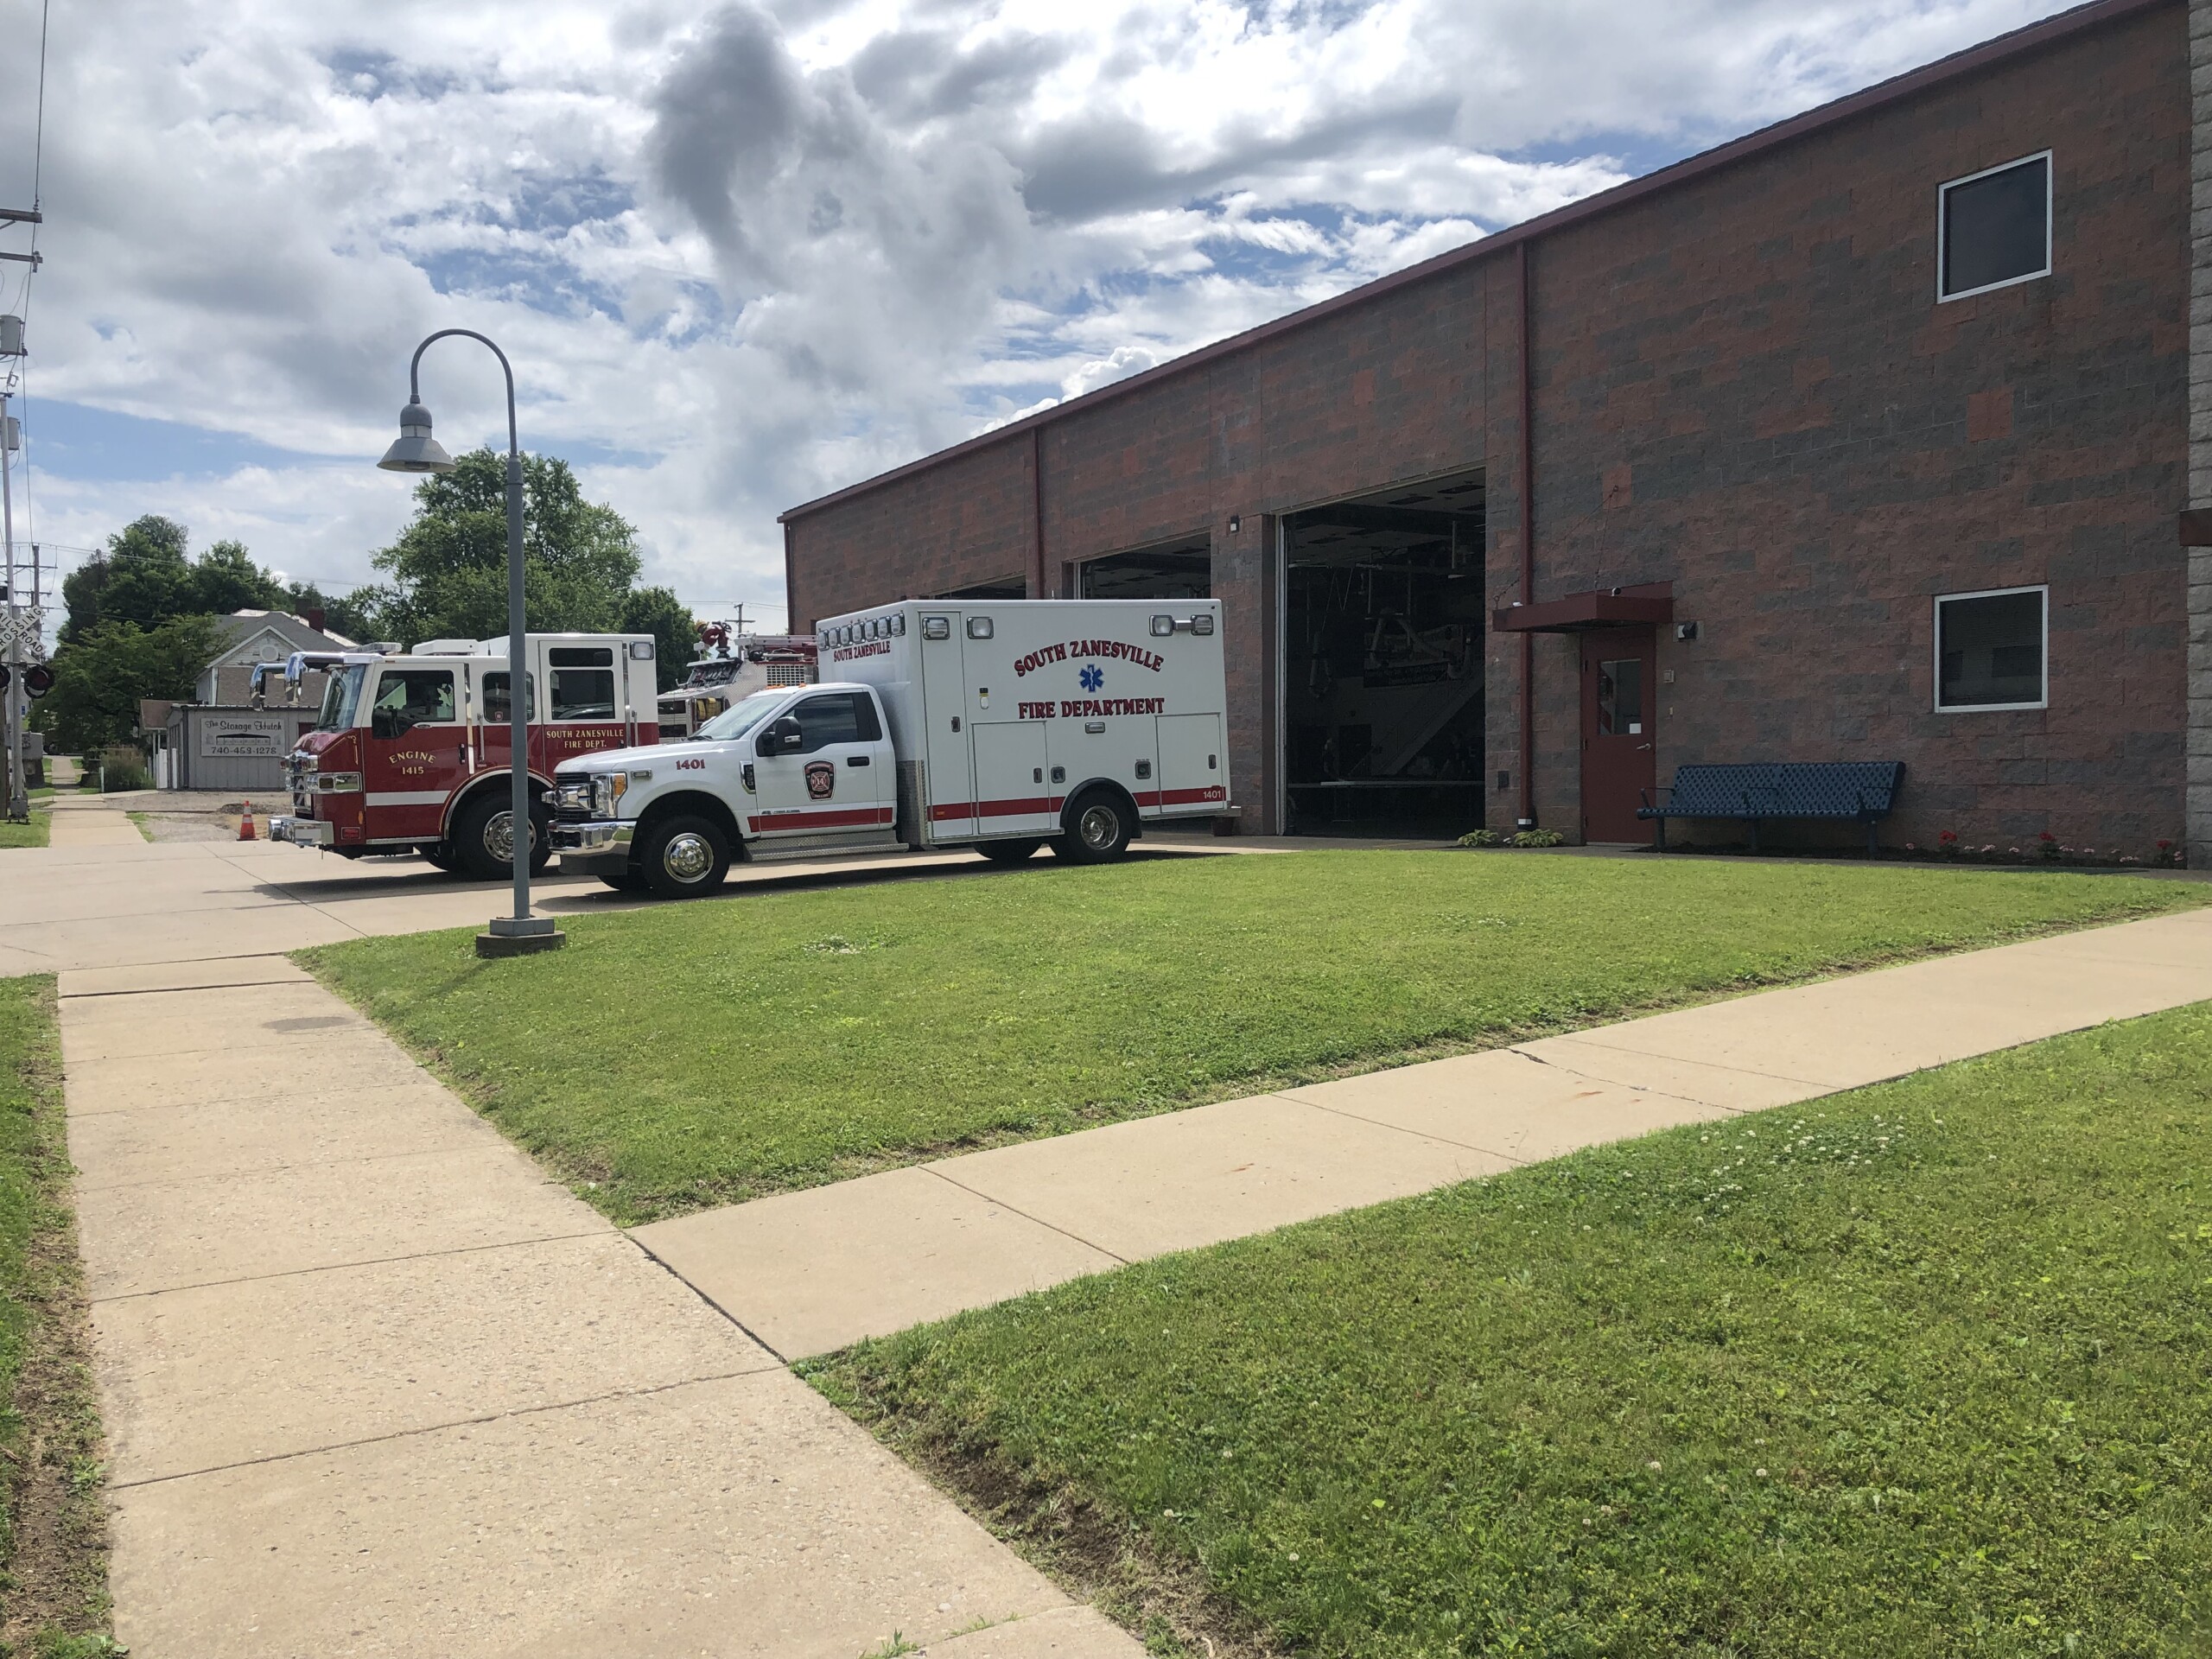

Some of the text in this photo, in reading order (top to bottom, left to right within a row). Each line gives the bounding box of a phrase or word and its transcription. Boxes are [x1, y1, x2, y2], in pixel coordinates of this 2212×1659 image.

[0, 608, 41, 646] ROSSING
[19, 631, 43, 652] ROAD
[833, 640, 891, 662] SOUTH ZANESVILLE
[1014, 639, 1165, 677] SOUTH ZANESVILLE
[1018, 697, 1165, 719] FIRE DEPARTMENT
[205, 720, 283, 733] The Storage Hutch
[546, 729, 624, 739] SOUTH ZANESVILLE
[585, 740, 607, 748] DEPT.
[389, 750, 436, 764] ENGINE
[402, 766, 424, 774] 1415
[676, 758, 706, 770] 1401
[1203, 790, 1221, 799] 1401
